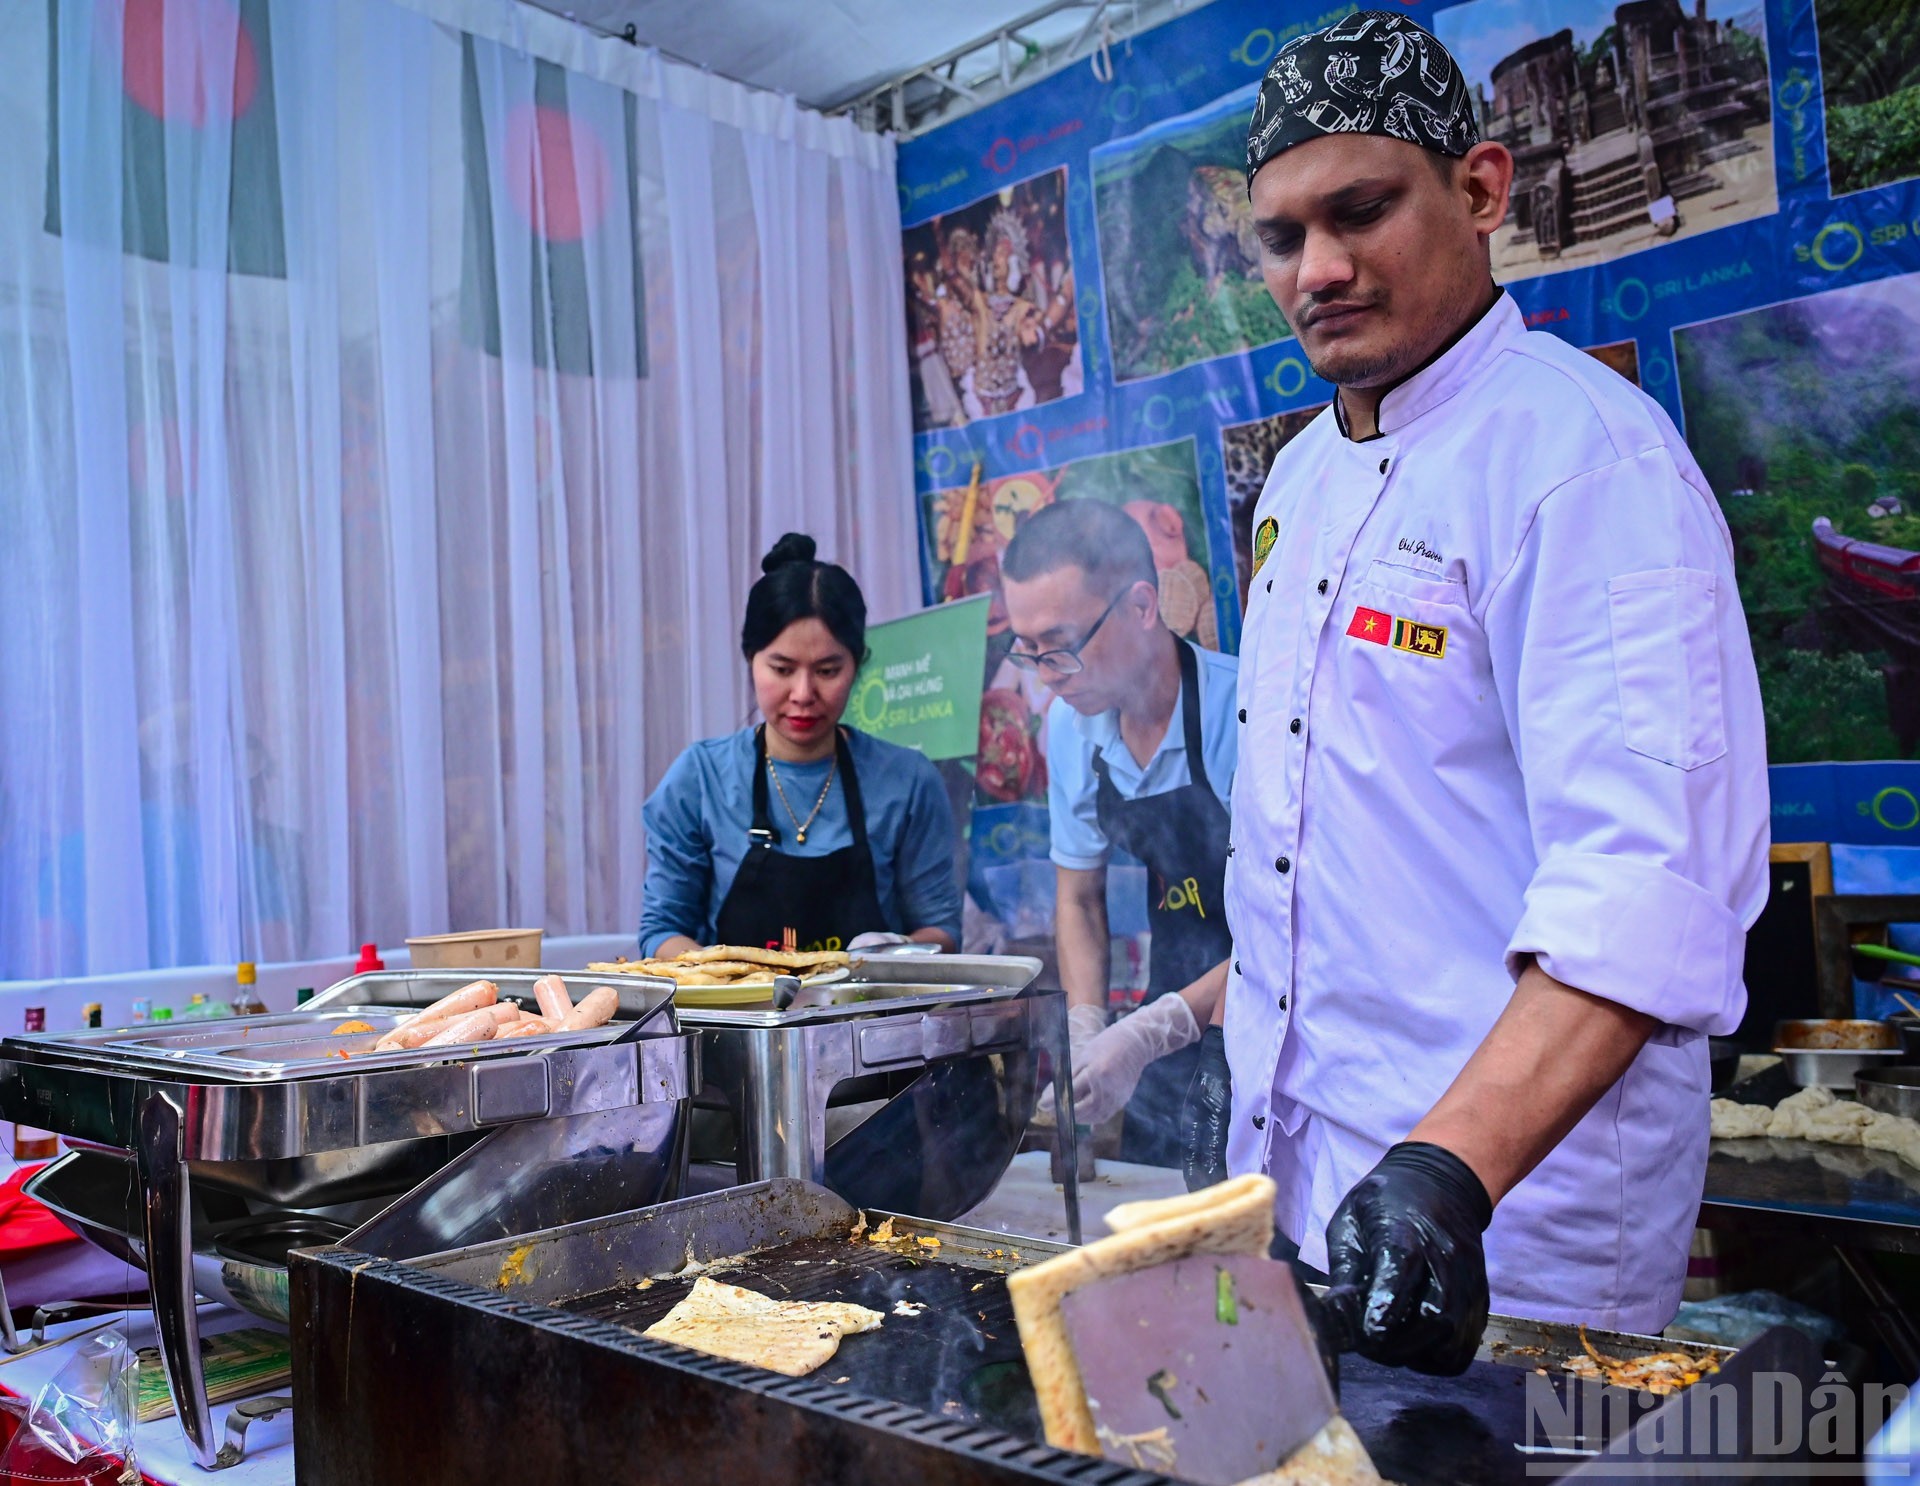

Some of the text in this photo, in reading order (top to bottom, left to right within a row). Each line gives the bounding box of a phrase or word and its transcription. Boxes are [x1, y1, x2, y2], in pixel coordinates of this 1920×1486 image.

[1870, 223, 1907, 246] SRI
[1653, 279, 1682, 300] SRI
[1685, 260, 1753, 291] LANKA
[1772, 802, 1816, 817] NKA
